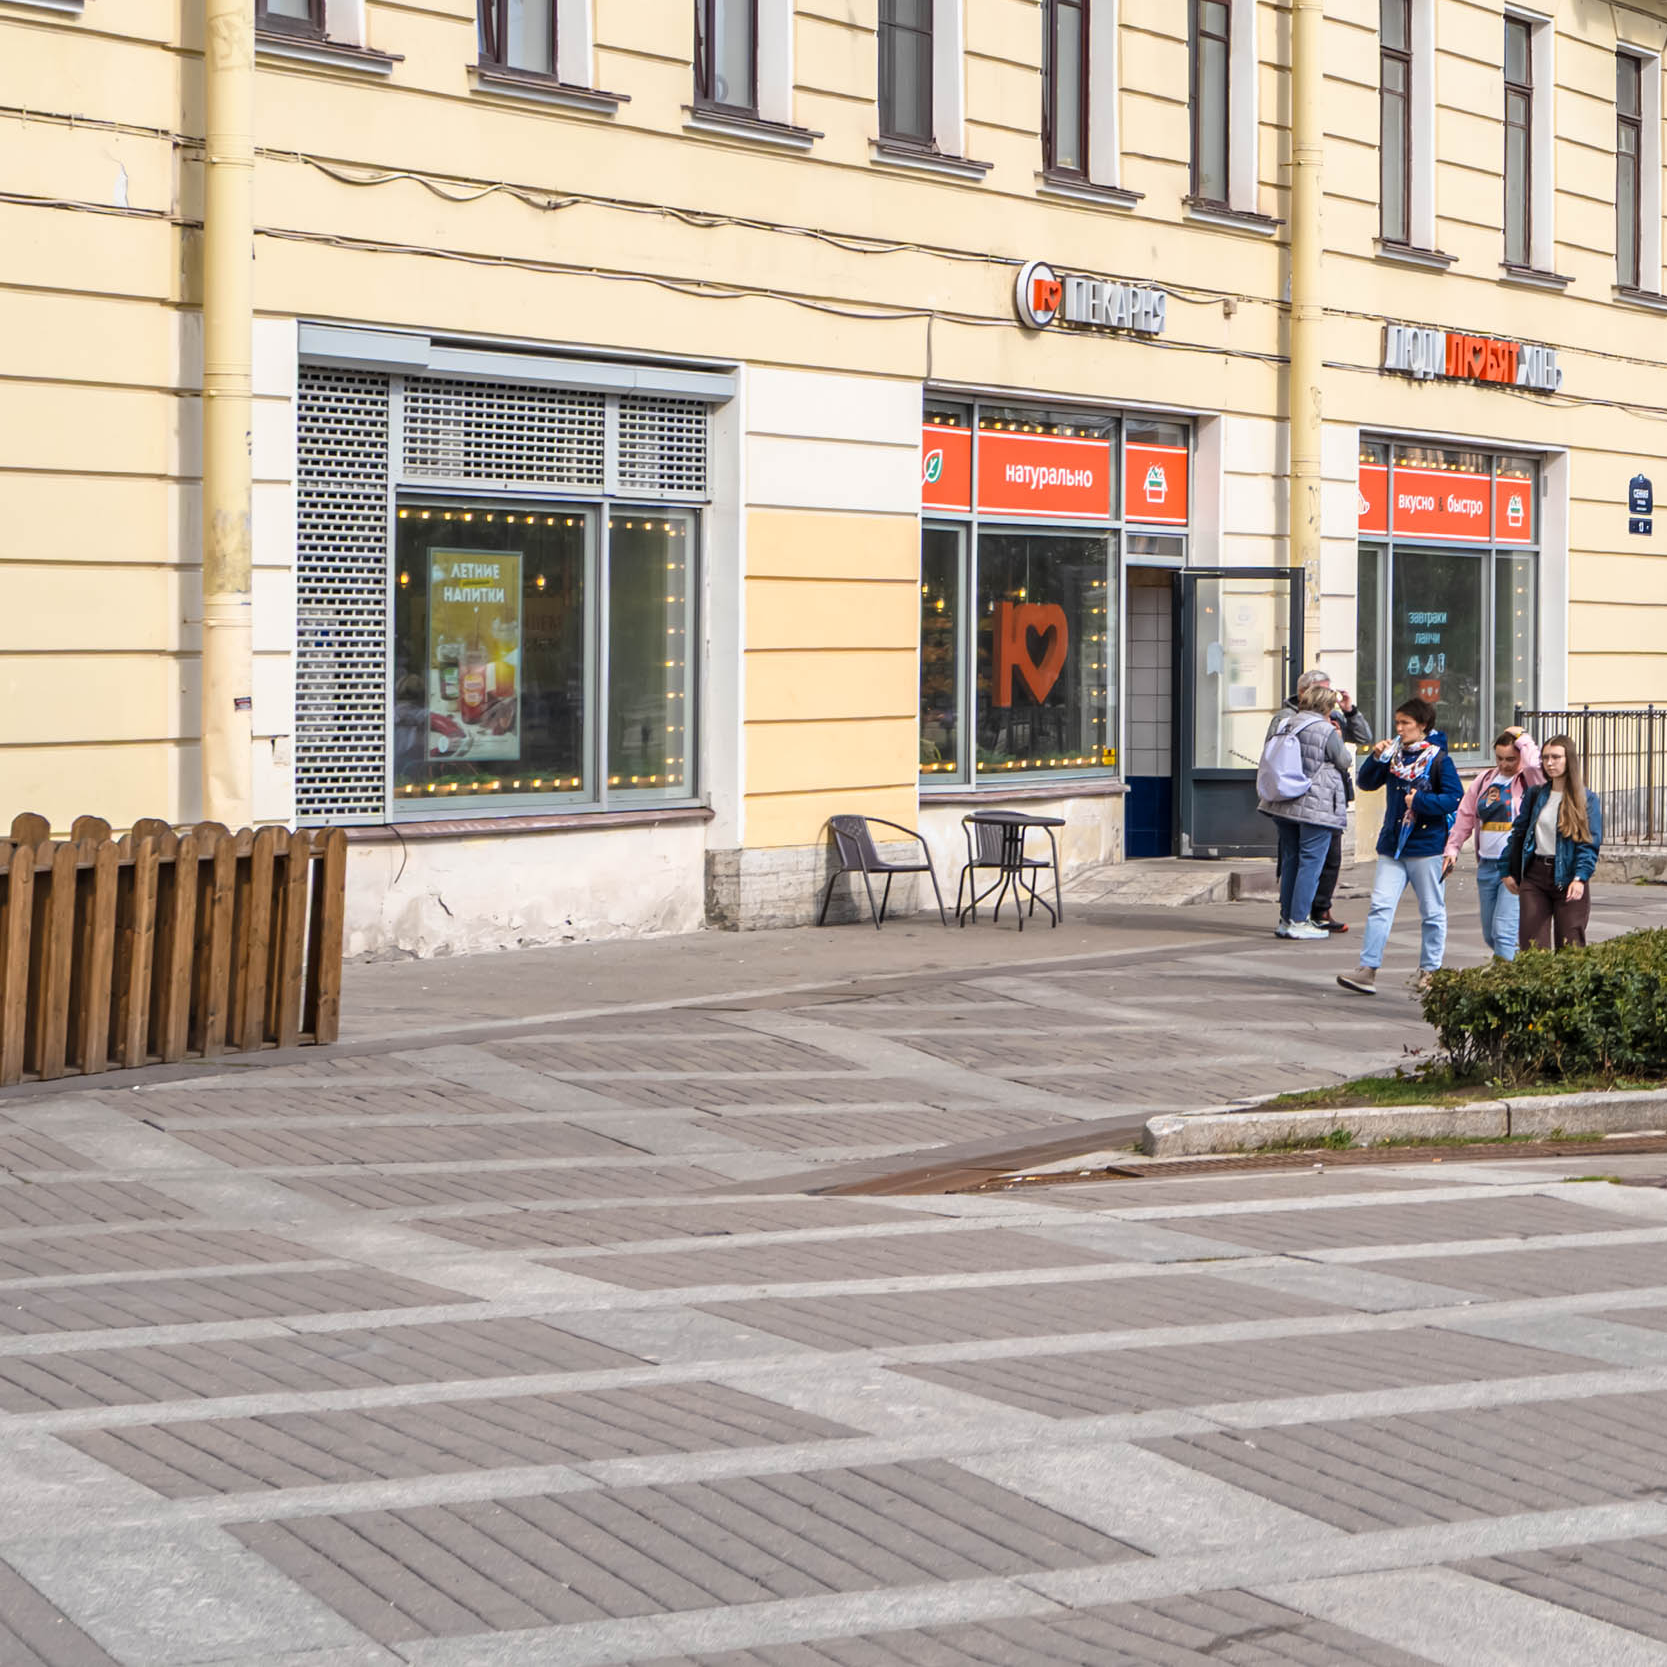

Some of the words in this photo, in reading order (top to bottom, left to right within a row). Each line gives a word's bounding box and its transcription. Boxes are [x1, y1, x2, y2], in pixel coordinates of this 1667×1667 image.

[1064, 276, 1167, 333] ПЕКАРНЯ
[1384, 324, 1447, 380] ЛЮДИ
[1446, 333, 1521, 385] ЛЮБЯТ
[1005, 463, 1093, 489] натурально
[1398, 493, 1435, 514] вкусно
[1447, 494, 1484, 518] быстро
[450, 562, 500, 580] ЛЕТНИЕ
[443, 586, 505, 603] НАПИТКИ
[1407, 612, 1447, 627] завтраки
[1414, 632, 1441, 645] ланчи
